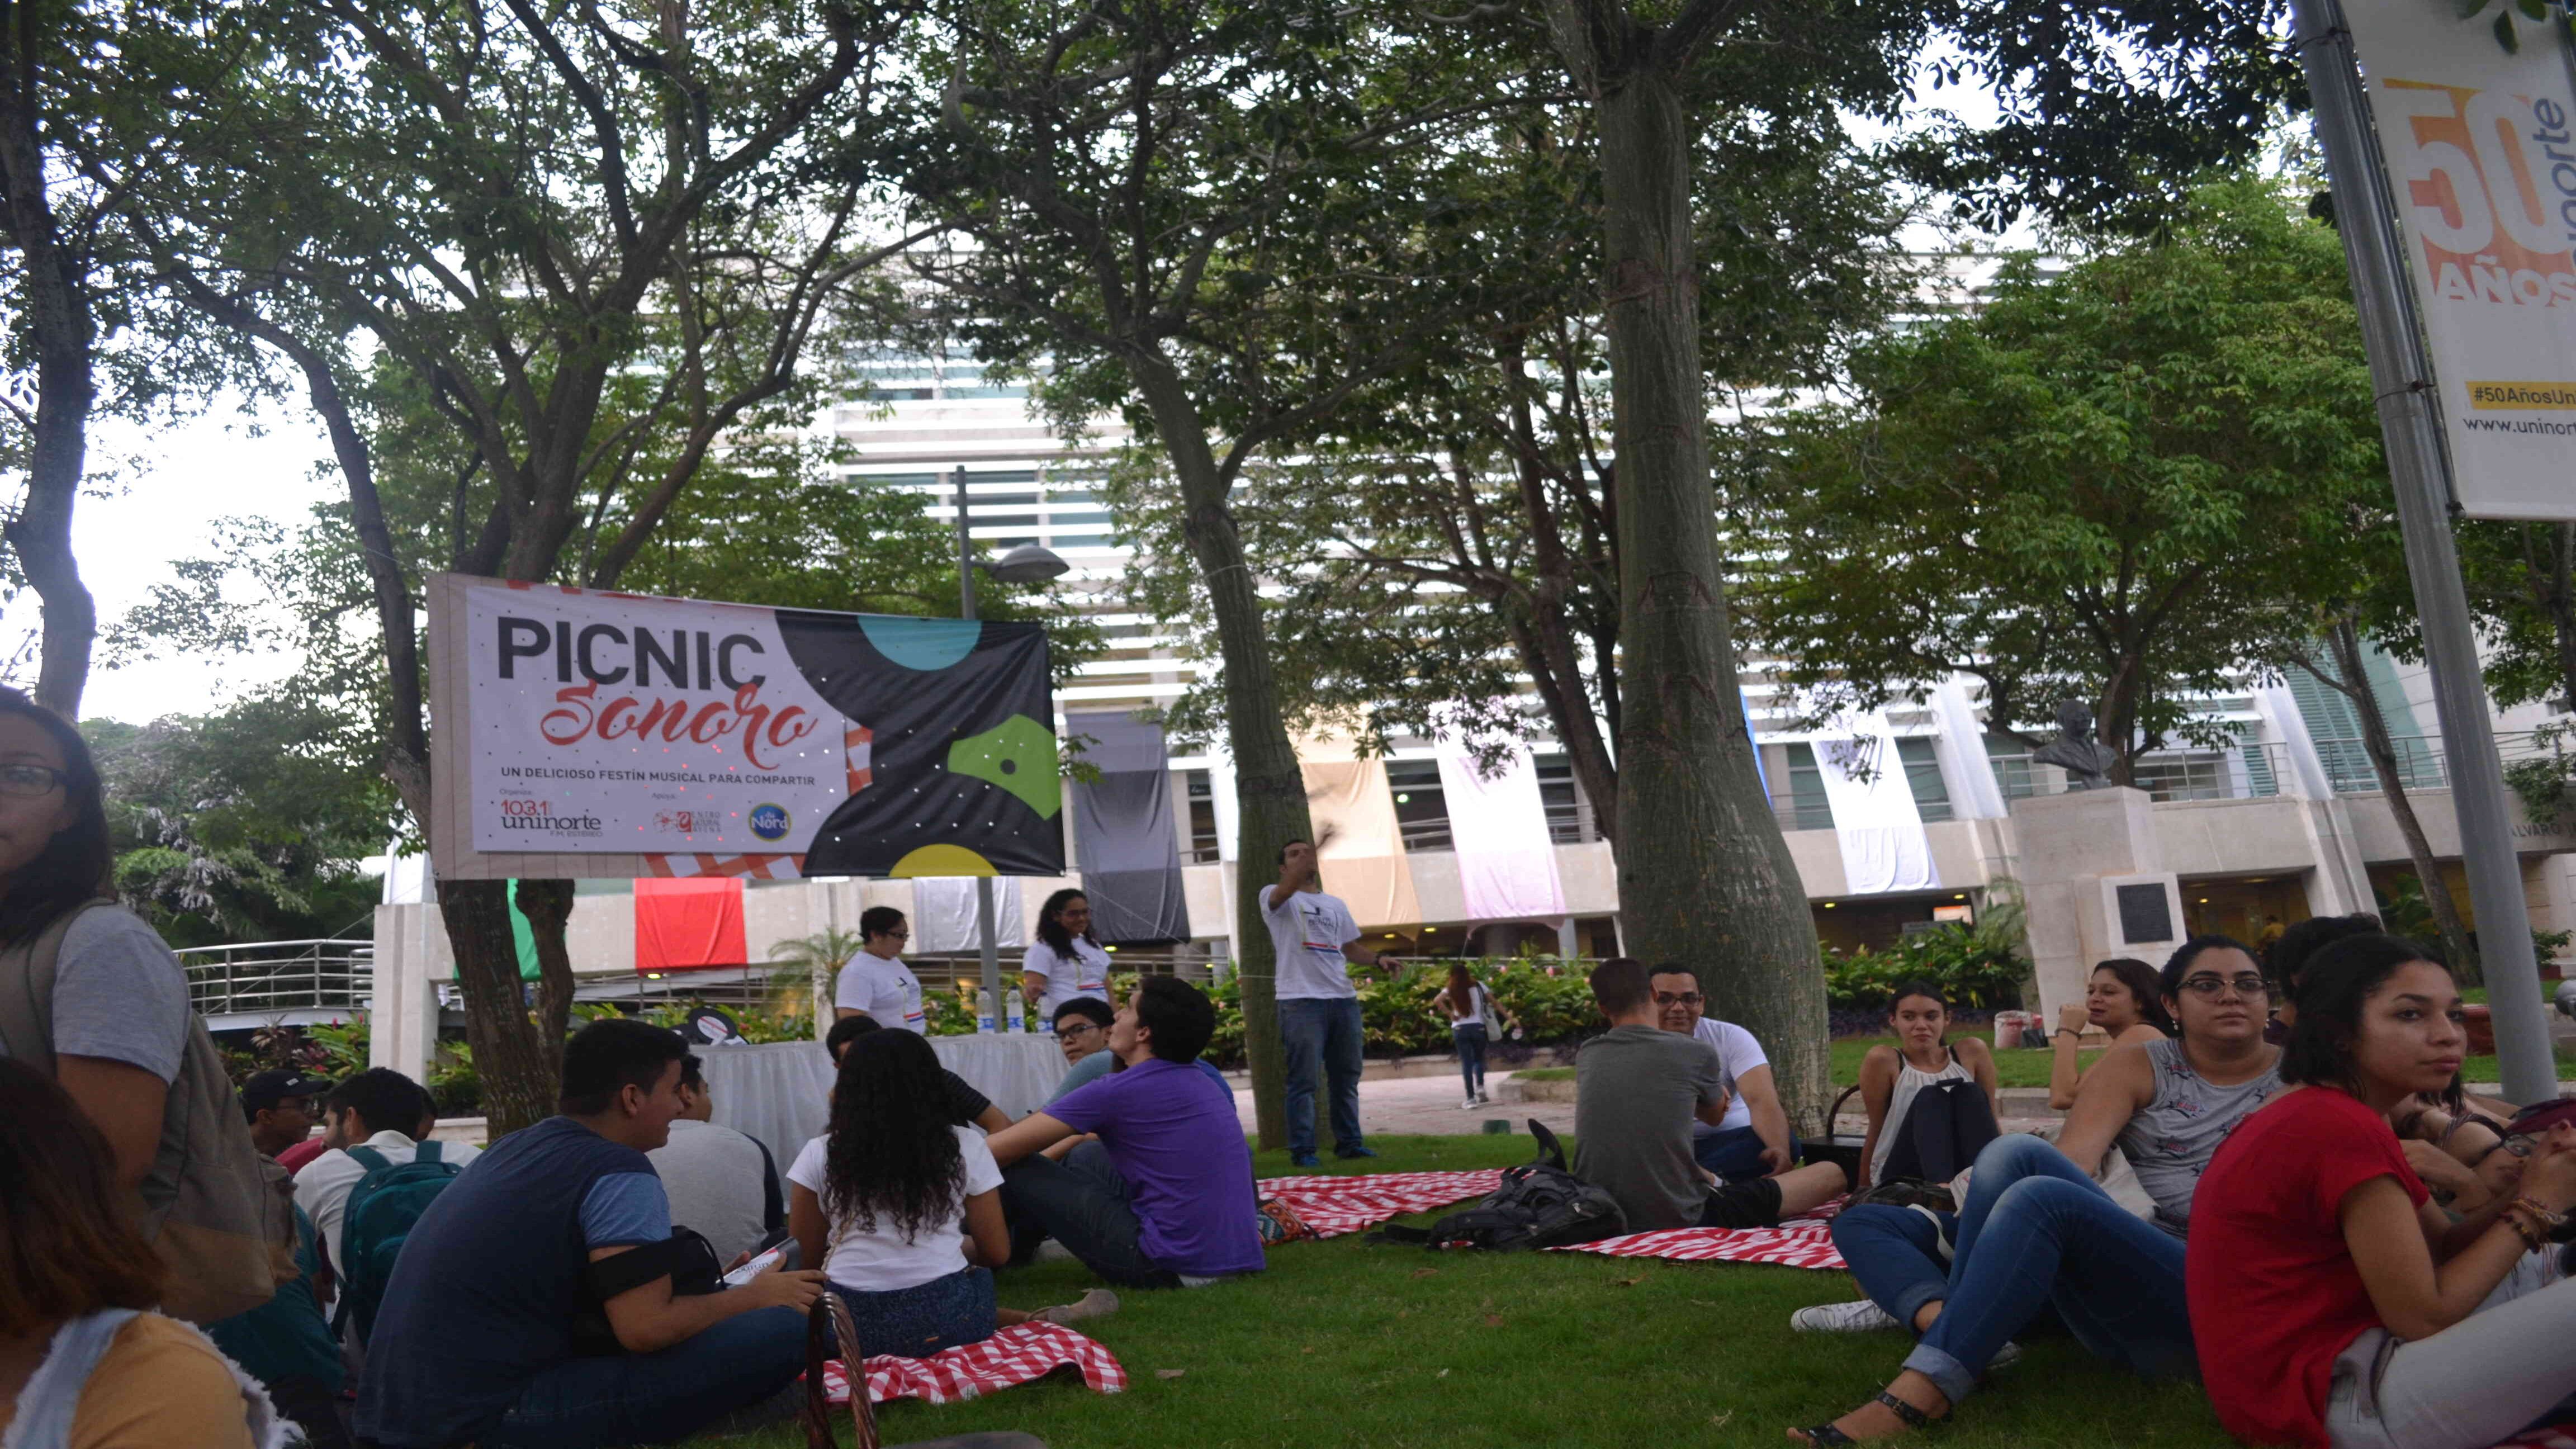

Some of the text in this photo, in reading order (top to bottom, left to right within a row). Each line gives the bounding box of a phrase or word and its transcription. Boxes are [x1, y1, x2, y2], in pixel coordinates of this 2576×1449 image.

[2386, 87, 2575, 255] 50
[2474, 386, 2576, 405] #50AñosUn
[497, 617, 766, 692] PICNIC
[540, 679, 818, 770] Sonoro
[501, 767, 815, 785] UN DELICIOSO FESTÍN MUSICAL PARA COMPARTIR
[501, 813, 602, 830] uninorte
[751, 815, 788, 830] Nord
